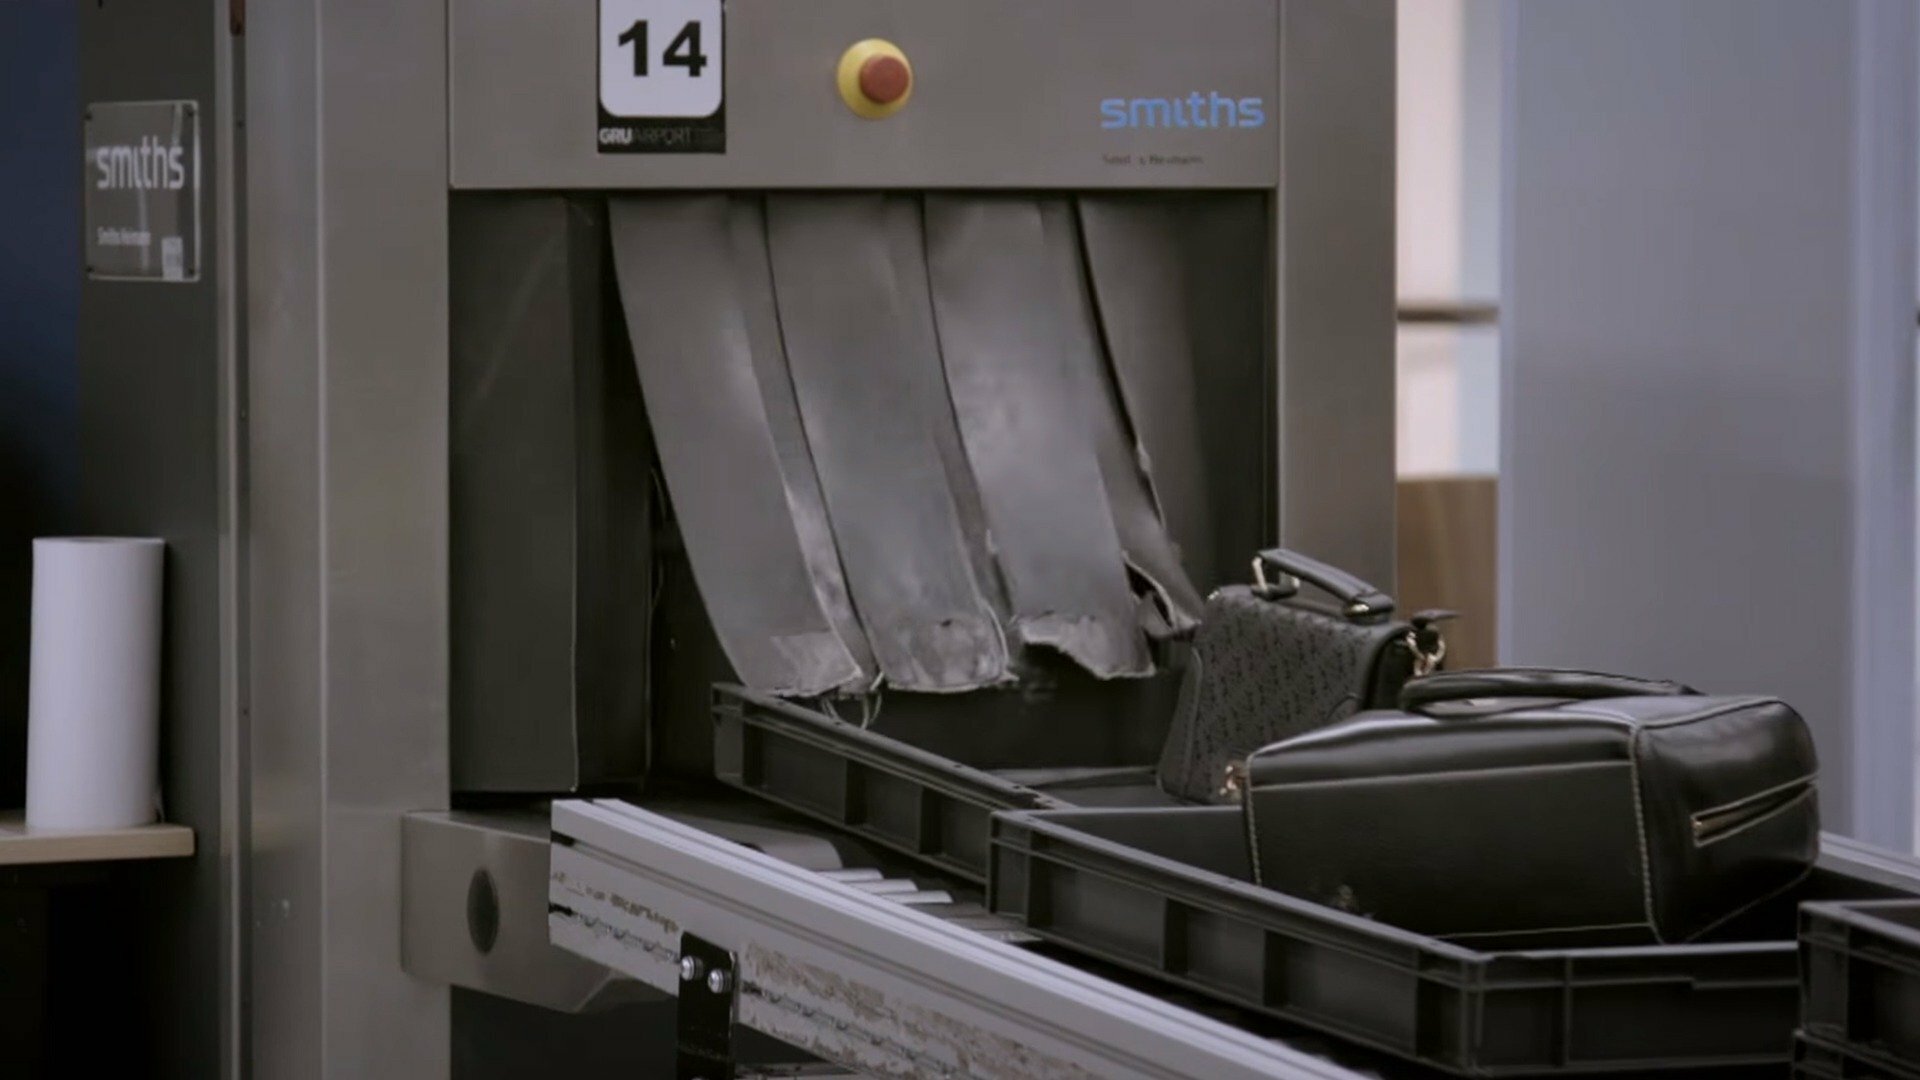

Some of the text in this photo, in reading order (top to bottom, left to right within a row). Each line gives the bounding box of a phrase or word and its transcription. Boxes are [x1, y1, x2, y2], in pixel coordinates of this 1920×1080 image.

[618, 20, 707, 77] 14
[1101, 91, 1267, 129] smiths
[97, 136, 185, 189] smiths
